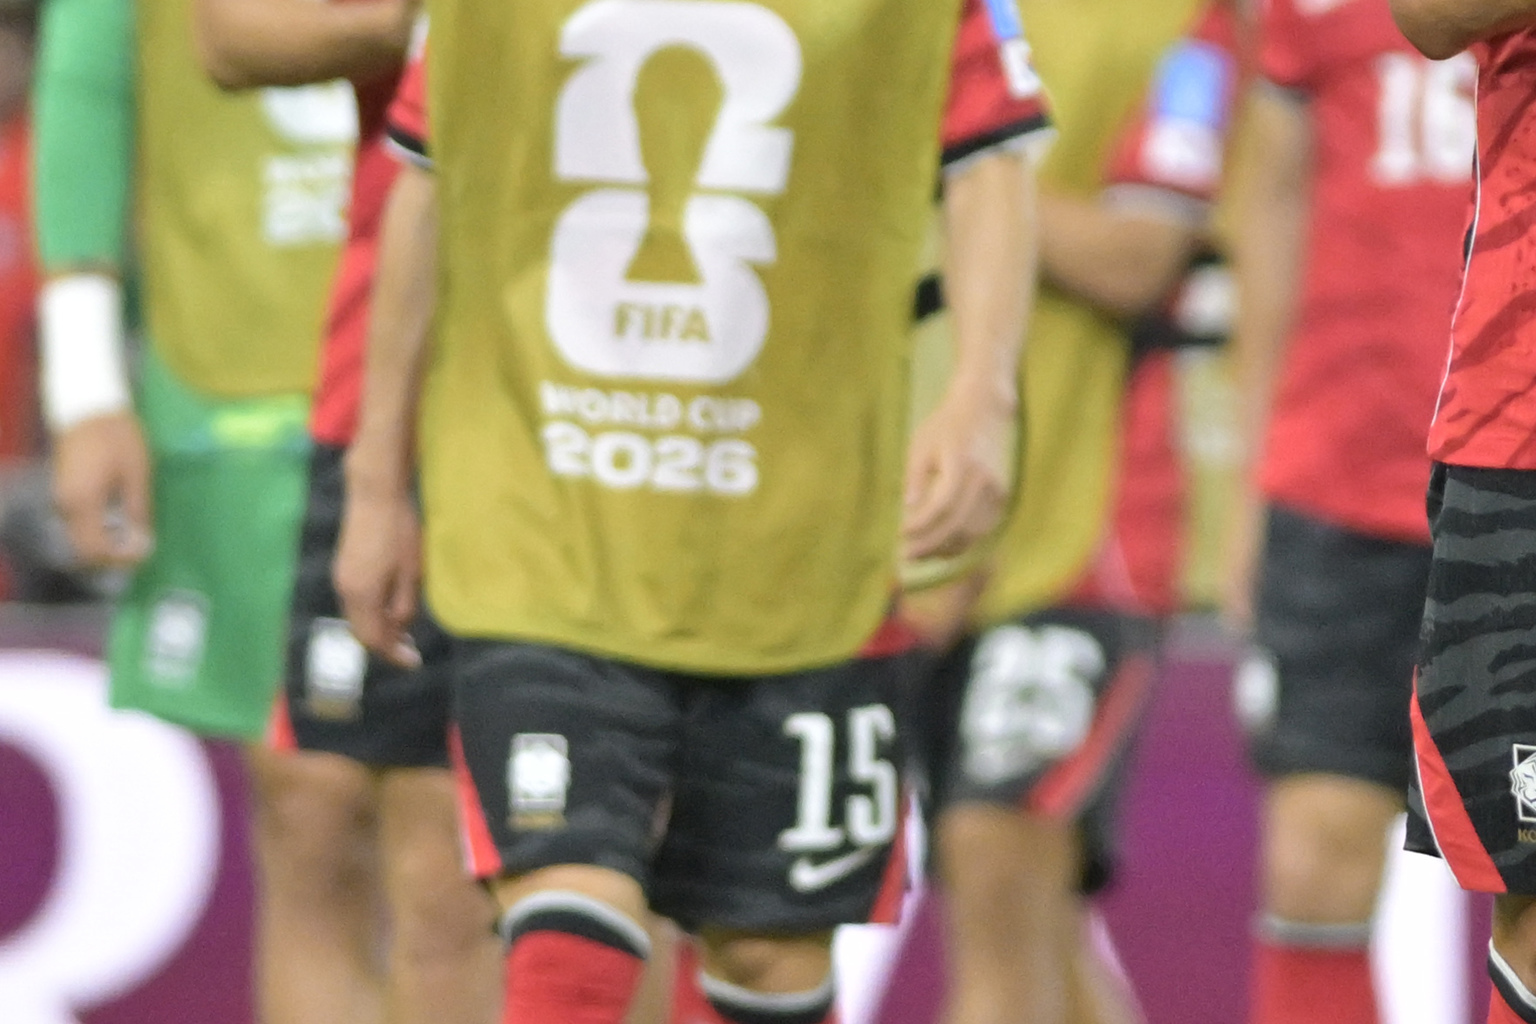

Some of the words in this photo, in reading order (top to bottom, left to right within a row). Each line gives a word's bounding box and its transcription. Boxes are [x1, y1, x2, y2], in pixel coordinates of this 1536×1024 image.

[611, 301, 711, 343] FIFA
[539, 379, 682, 429] WORLD
[688, 394, 762, 433] CUP
[541, 420, 760, 497] 2026
[778, 703, 898, 851] 15
